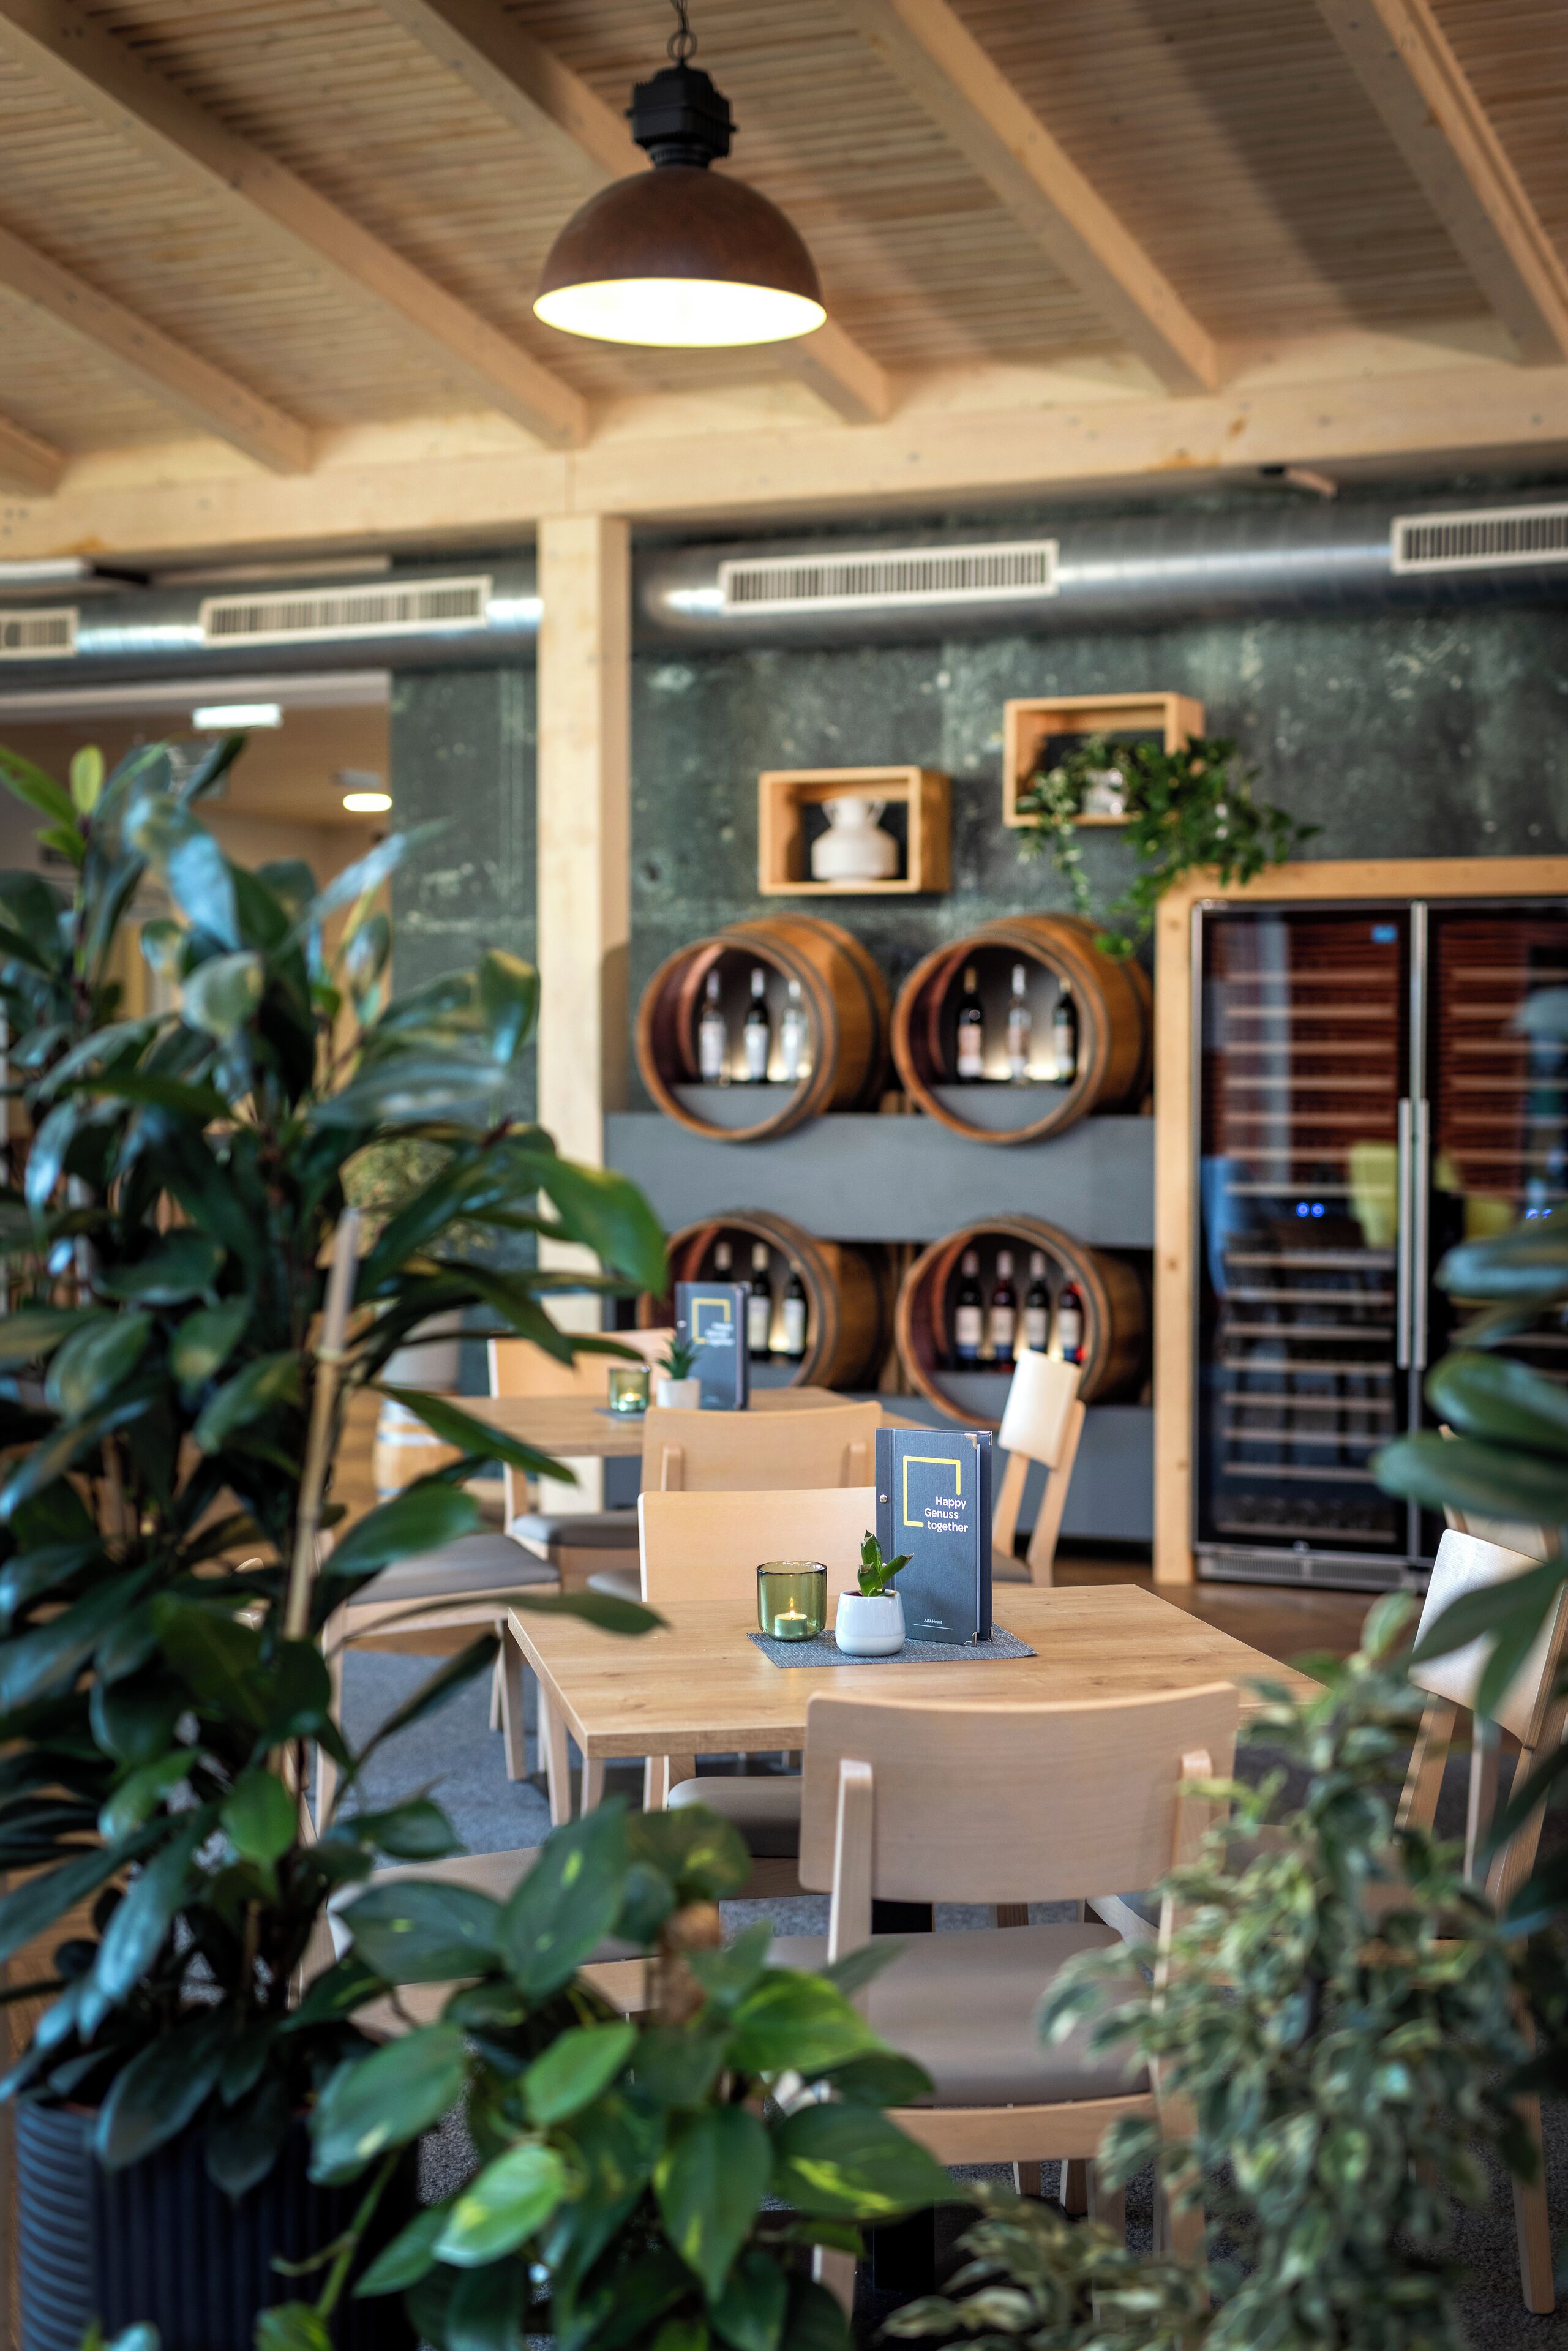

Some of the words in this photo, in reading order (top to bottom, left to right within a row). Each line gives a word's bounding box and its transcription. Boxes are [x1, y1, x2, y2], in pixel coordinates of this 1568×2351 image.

[936, 1496, 967, 1510] Happy
[924, 1507, 959, 1520] Genuss
[927, 1520, 969, 1533] together
